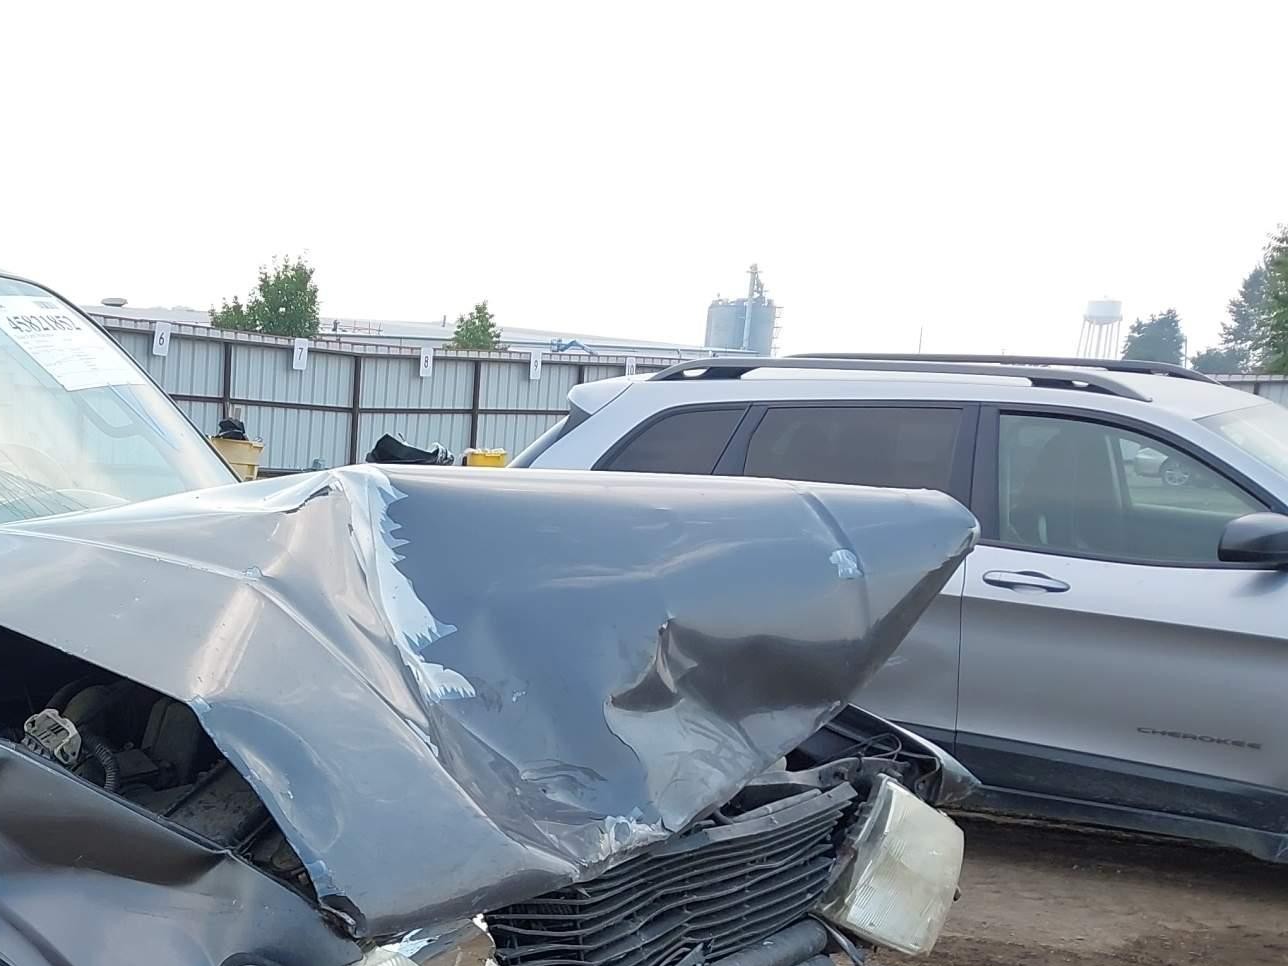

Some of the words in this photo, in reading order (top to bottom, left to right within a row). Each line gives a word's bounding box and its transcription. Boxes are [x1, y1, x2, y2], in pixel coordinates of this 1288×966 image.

[5, 315, 82, 332] 45821852
[158, 331, 165, 346] 6
[297, 347, 304, 361] 7
[423, 355, 429, 369] 8
[534, 359, 539, 370] 9
[1136, 727, 1263, 750] CHEROKEE
